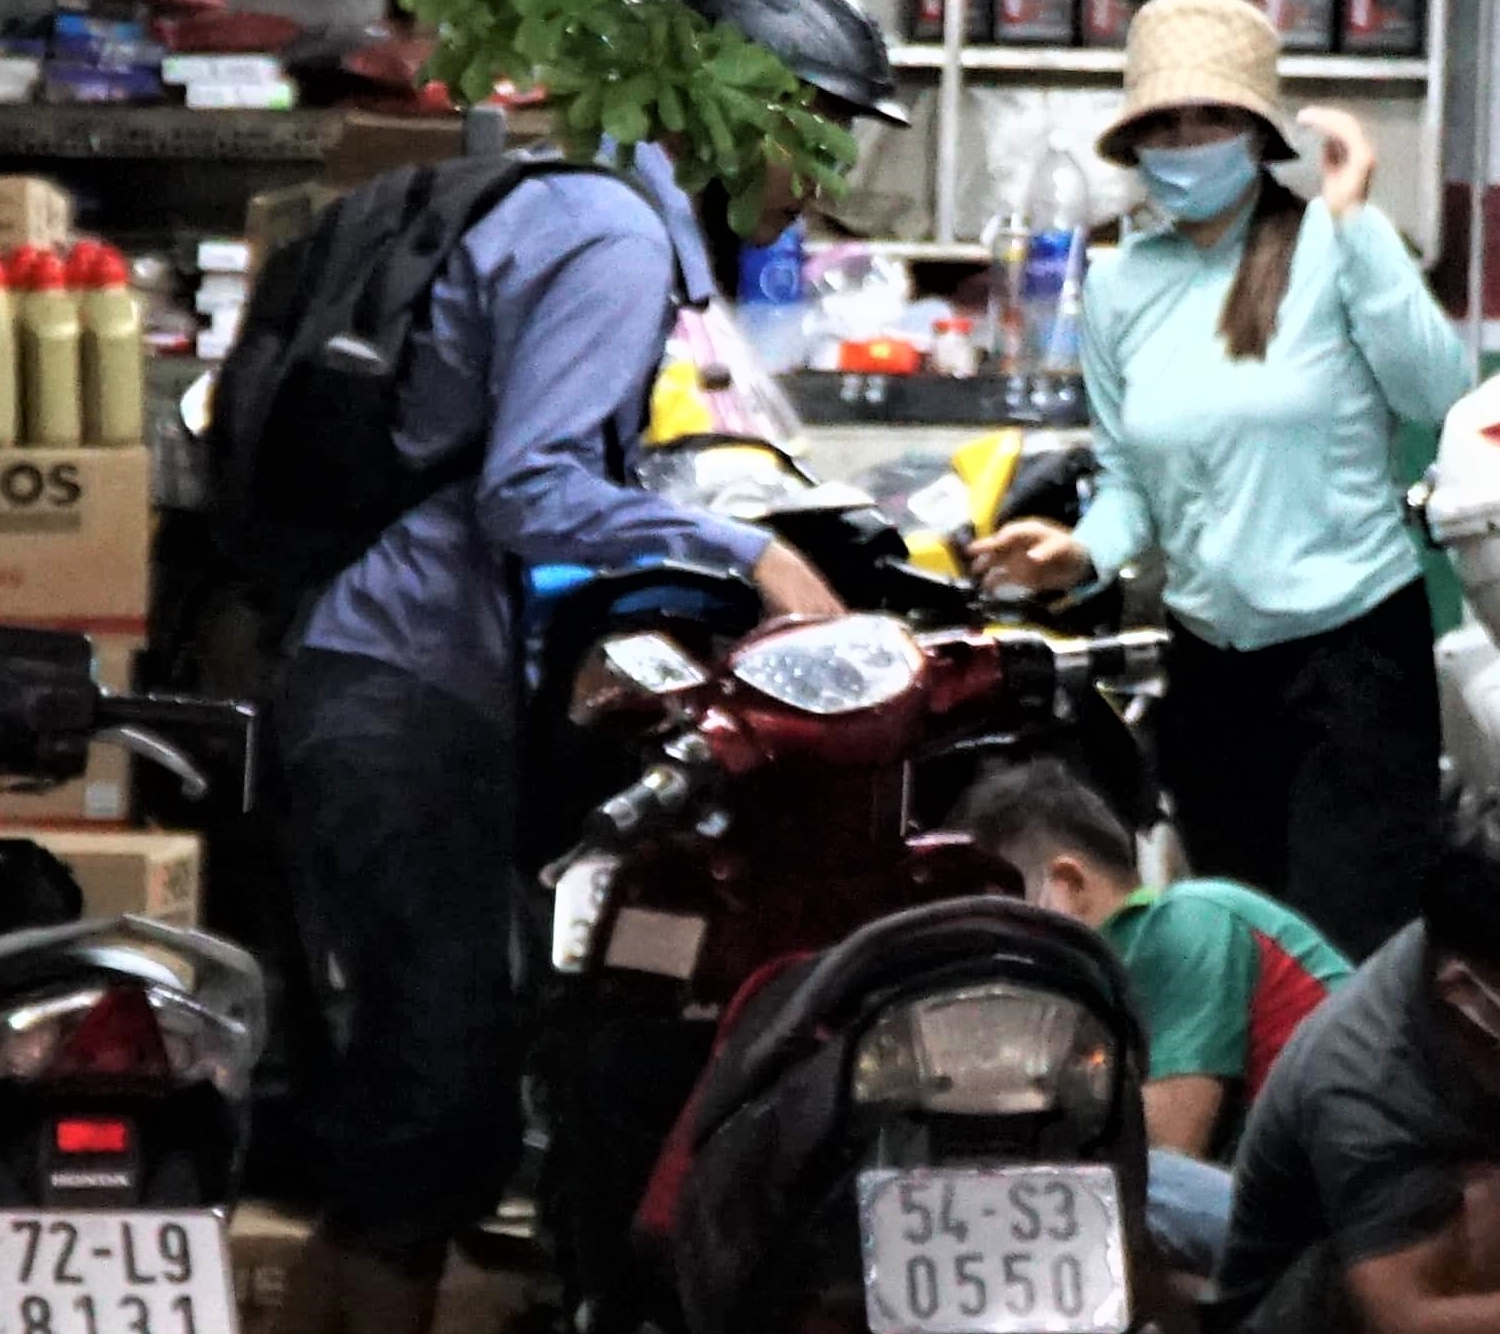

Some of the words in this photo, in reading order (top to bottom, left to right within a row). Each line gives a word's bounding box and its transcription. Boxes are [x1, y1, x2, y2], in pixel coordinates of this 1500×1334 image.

[900, 1179, 1079, 1245] 54-S3
[12, 1220, 194, 1286] 72-L9
[906, 1252, 1084, 1319] 0550
